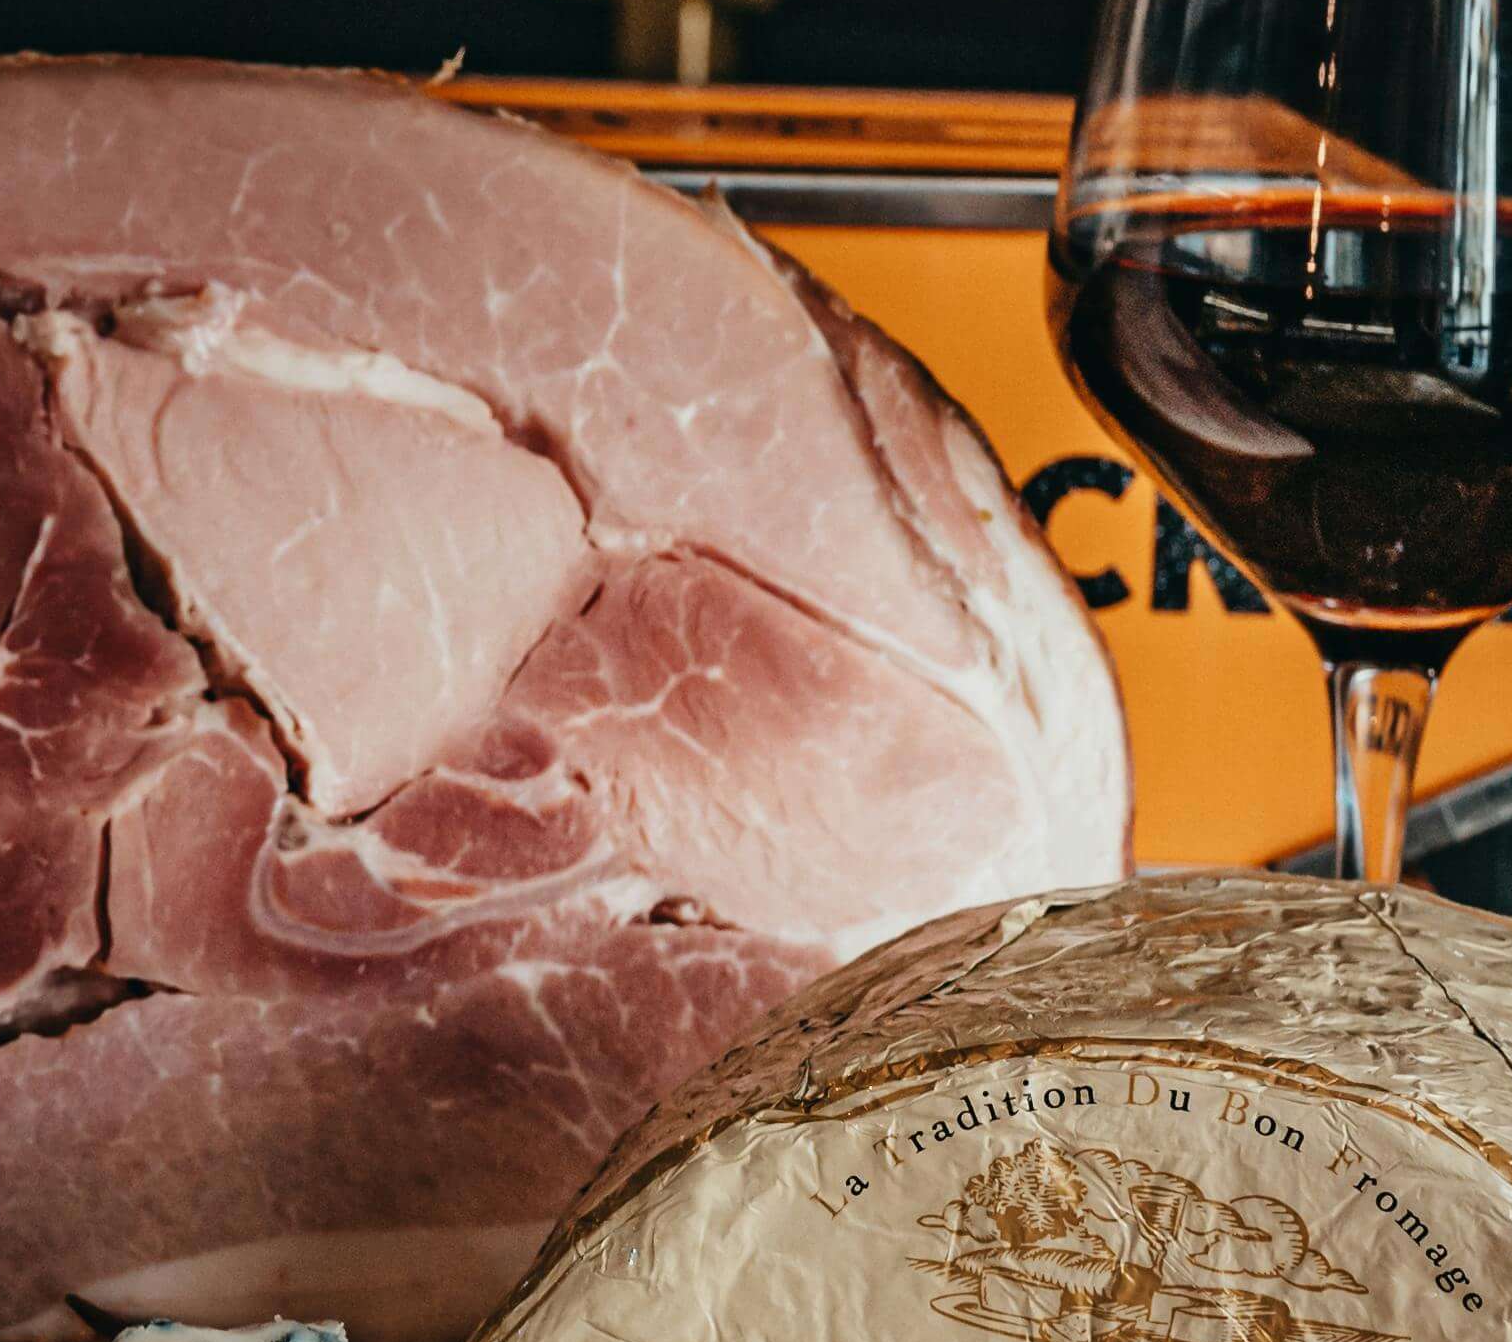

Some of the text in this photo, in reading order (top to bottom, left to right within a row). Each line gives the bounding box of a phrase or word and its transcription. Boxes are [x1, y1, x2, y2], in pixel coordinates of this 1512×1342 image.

[808, 1072, 1485, 1316] La Tradition Du Bon Fromage
